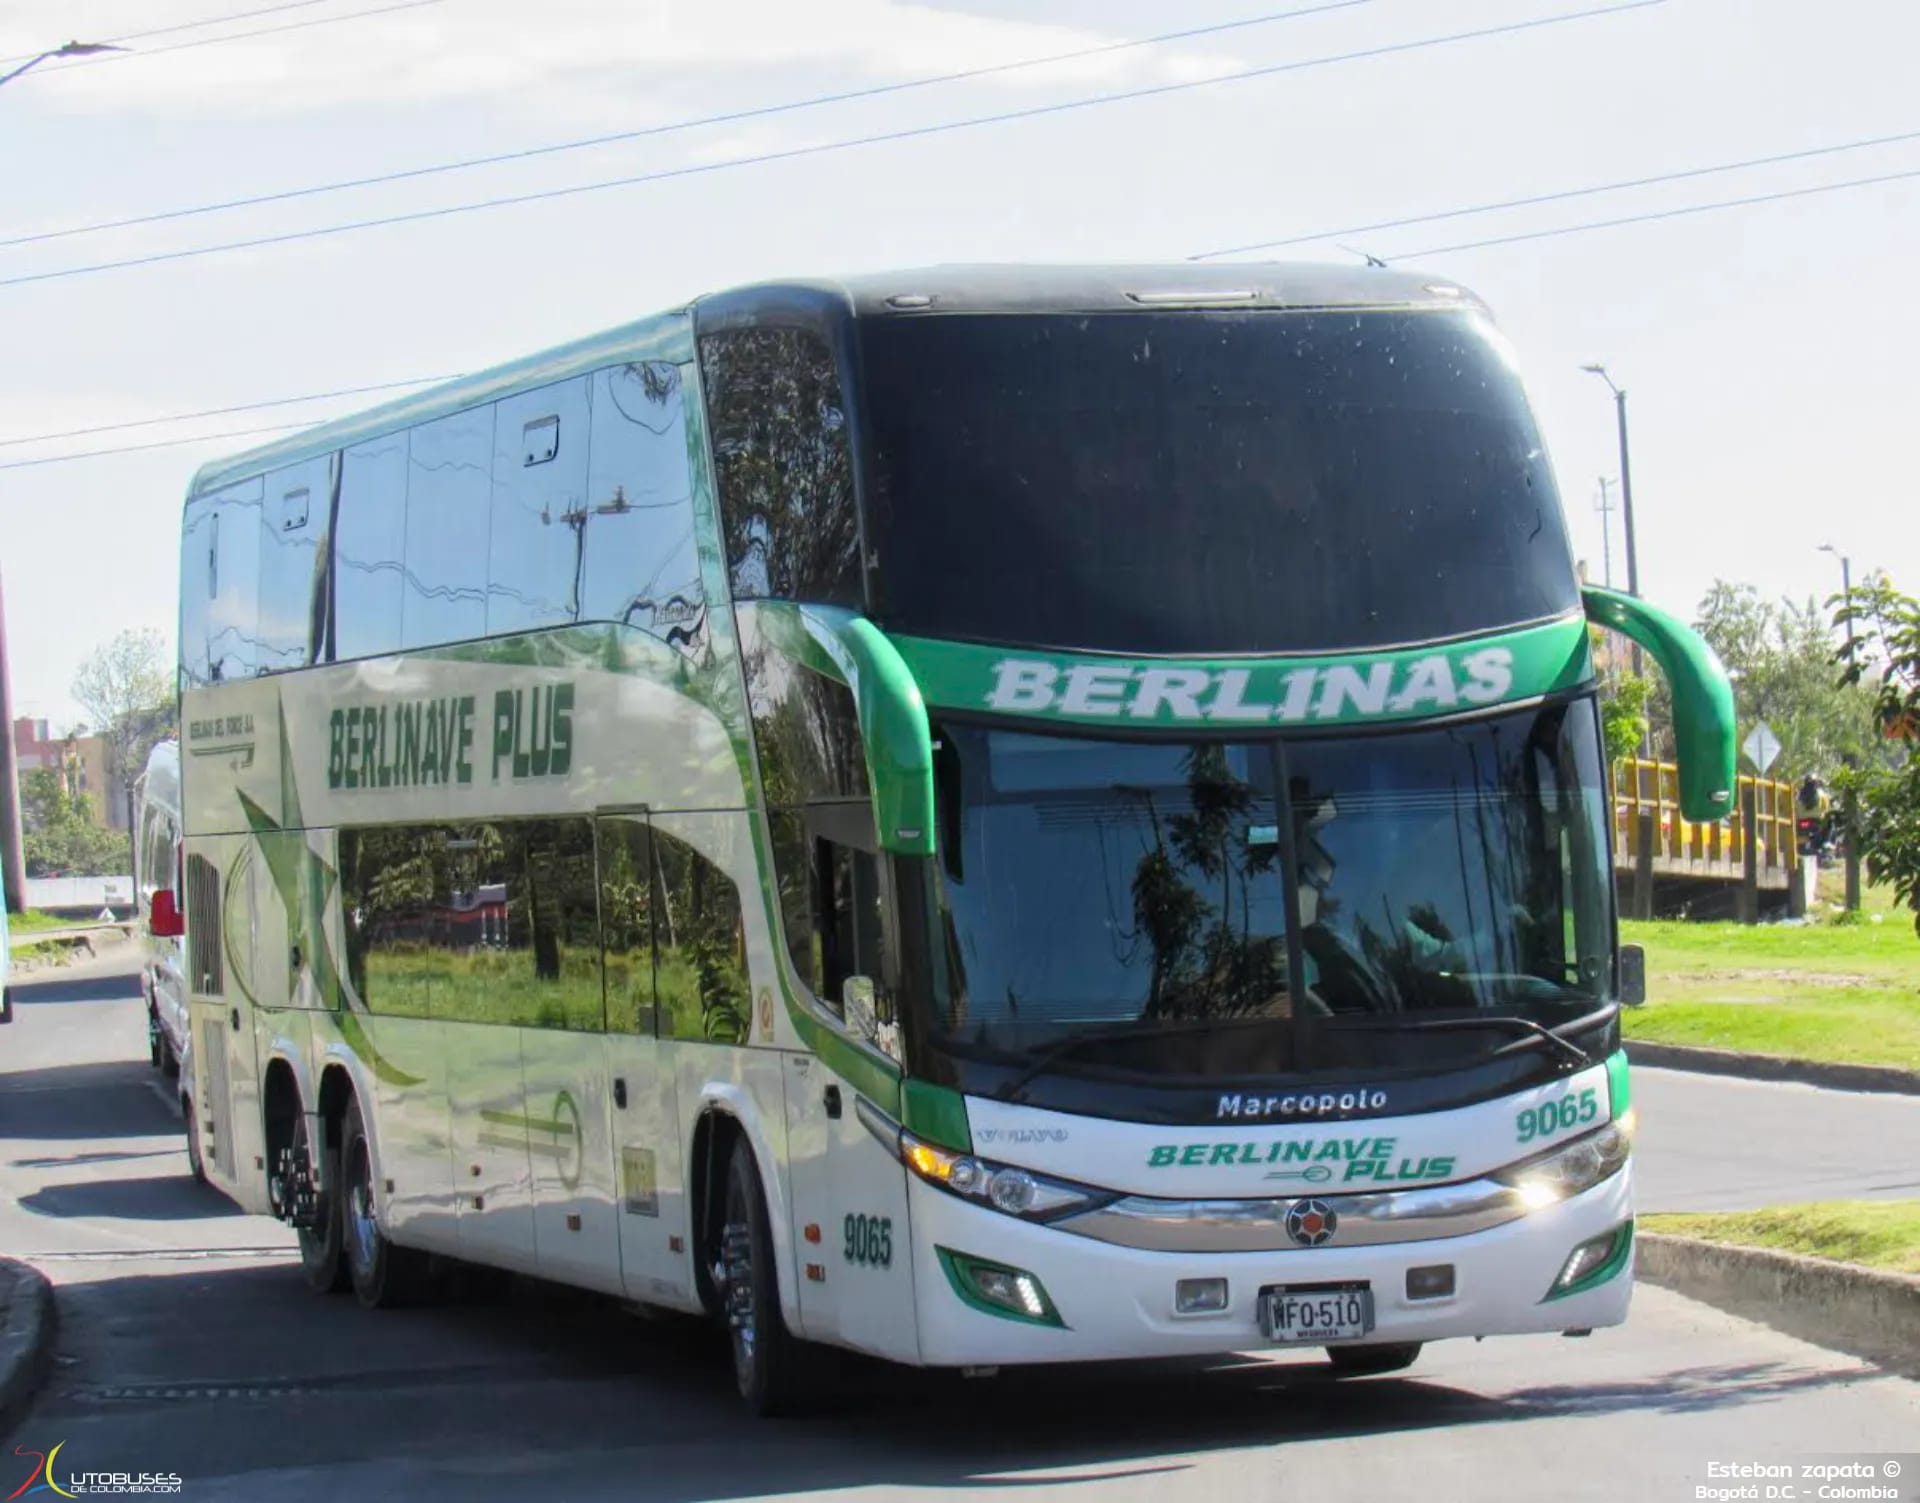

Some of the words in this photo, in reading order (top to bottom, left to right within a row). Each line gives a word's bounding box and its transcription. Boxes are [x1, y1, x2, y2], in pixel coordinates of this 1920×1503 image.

[988, 647, 1514, 721] BERLINAS
[328, 696, 475, 789] BERLINAVE
[492, 683, 575, 779] PLUS
[1216, 1089, 1387, 1118] Marcopolo
[1516, 1087, 1597, 1143] 9065
[1148, 1137, 1397, 1167] BERLINAVE
[1342, 1156, 1457, 1182] PLUS
[844, 1212, 892, 1267] 9065
